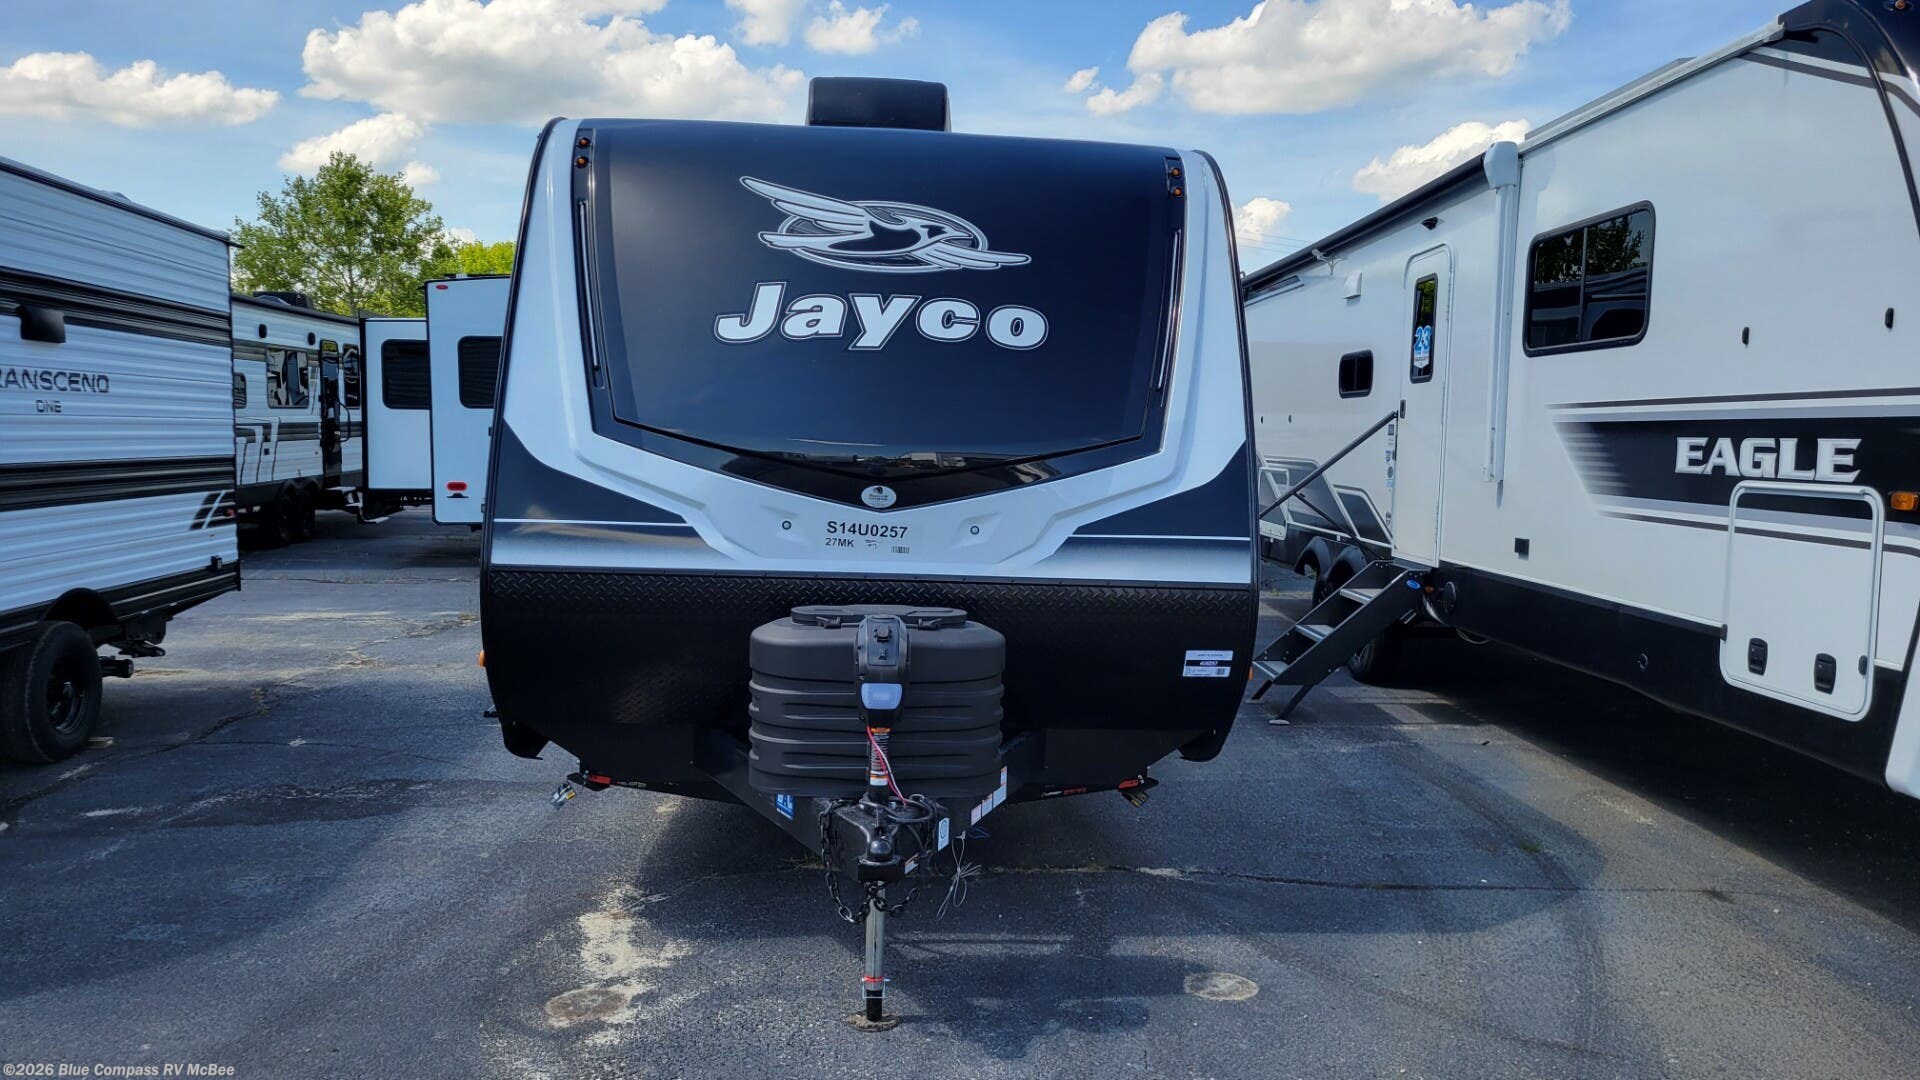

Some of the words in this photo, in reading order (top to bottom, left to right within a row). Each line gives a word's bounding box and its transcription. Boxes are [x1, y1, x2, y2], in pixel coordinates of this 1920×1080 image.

[714, 281, 1049, 350] Jayco
[36, 399, 62, 413] ONE
[1674, 436, 1863, 483] EAGLE
[827, 520, 908, 538] S14U0257
[825, 538, 854, 547] 27MK
